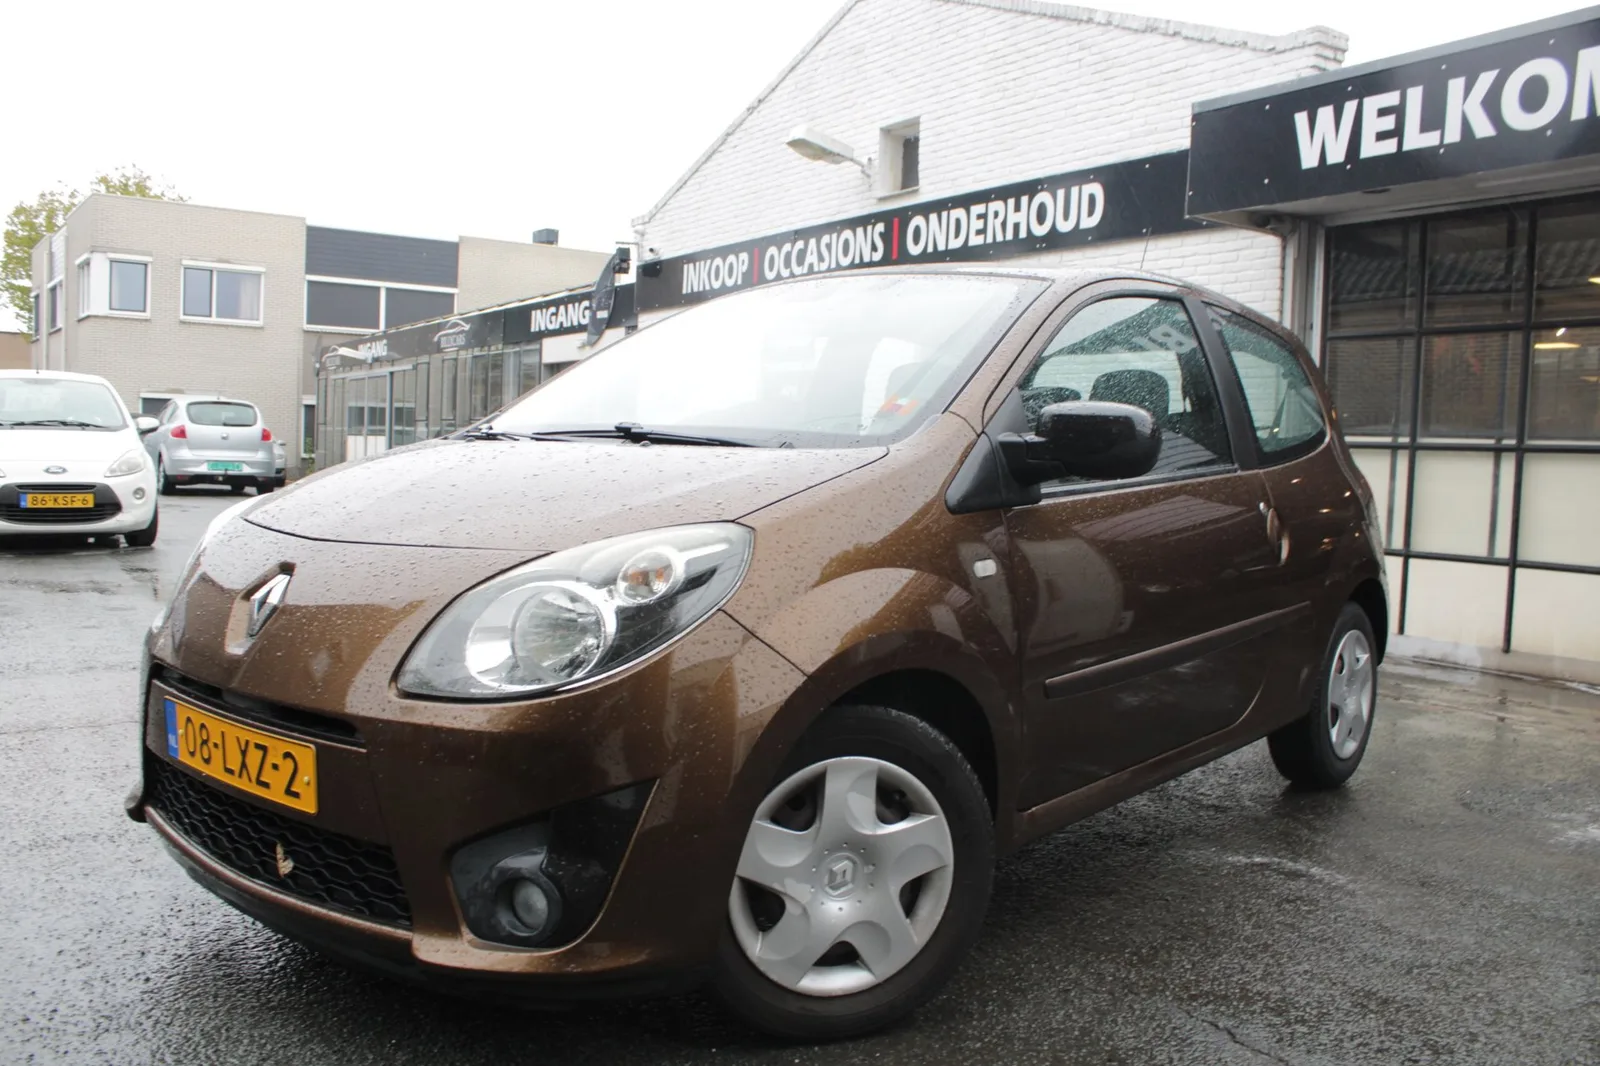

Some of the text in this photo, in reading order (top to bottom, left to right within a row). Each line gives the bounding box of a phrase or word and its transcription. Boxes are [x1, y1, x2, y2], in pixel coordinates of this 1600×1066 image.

[682, 181, 1105, 295] INKOOP OCCASIONS ONDERHOUD
[530, 300, 591, 332] INGANG
[31, 495, 89, 506] 86-KSF-6
[184, 716, 302, 800] 08-LXZ-2
